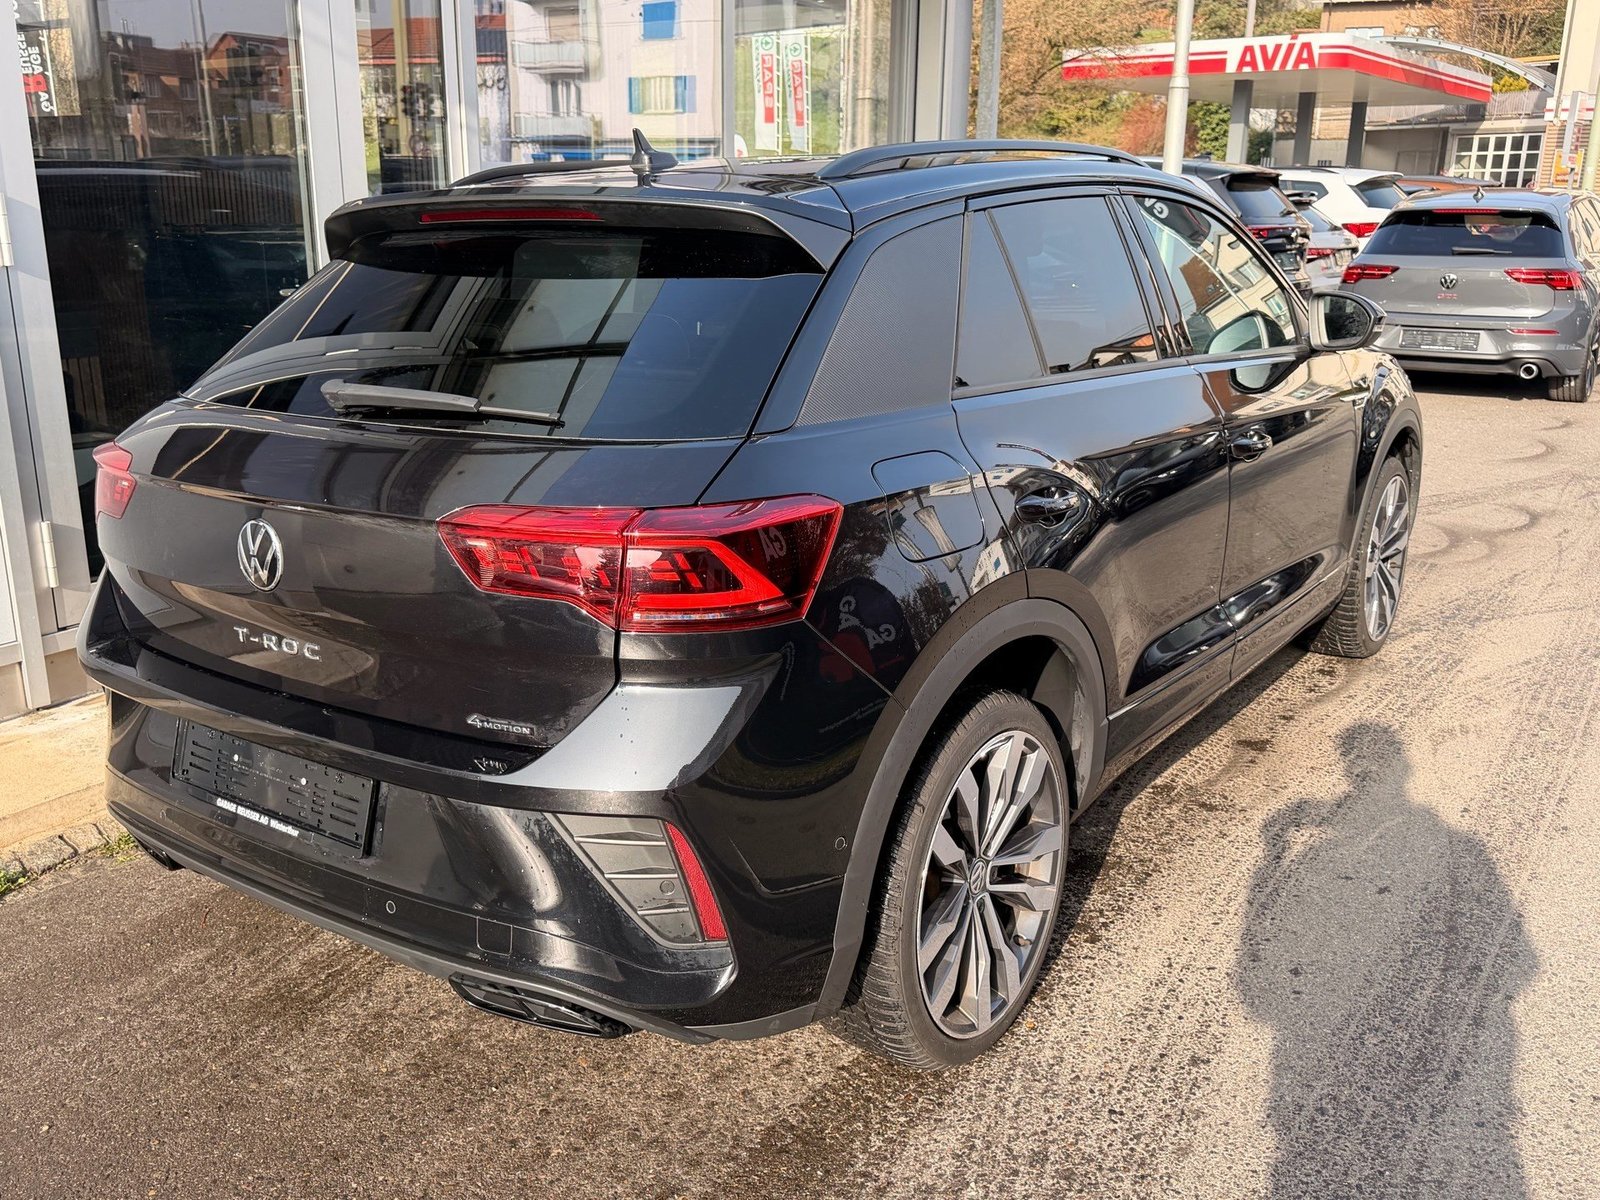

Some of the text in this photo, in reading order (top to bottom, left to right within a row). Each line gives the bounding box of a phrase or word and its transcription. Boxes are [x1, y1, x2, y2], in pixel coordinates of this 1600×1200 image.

[1235, 34, 1316, 73] AVIA
[233, 626, 320, 661] T-ROC
[466, 714, 530, 734] 4MOTION
[216, 797, 237, 813] GARAGE
